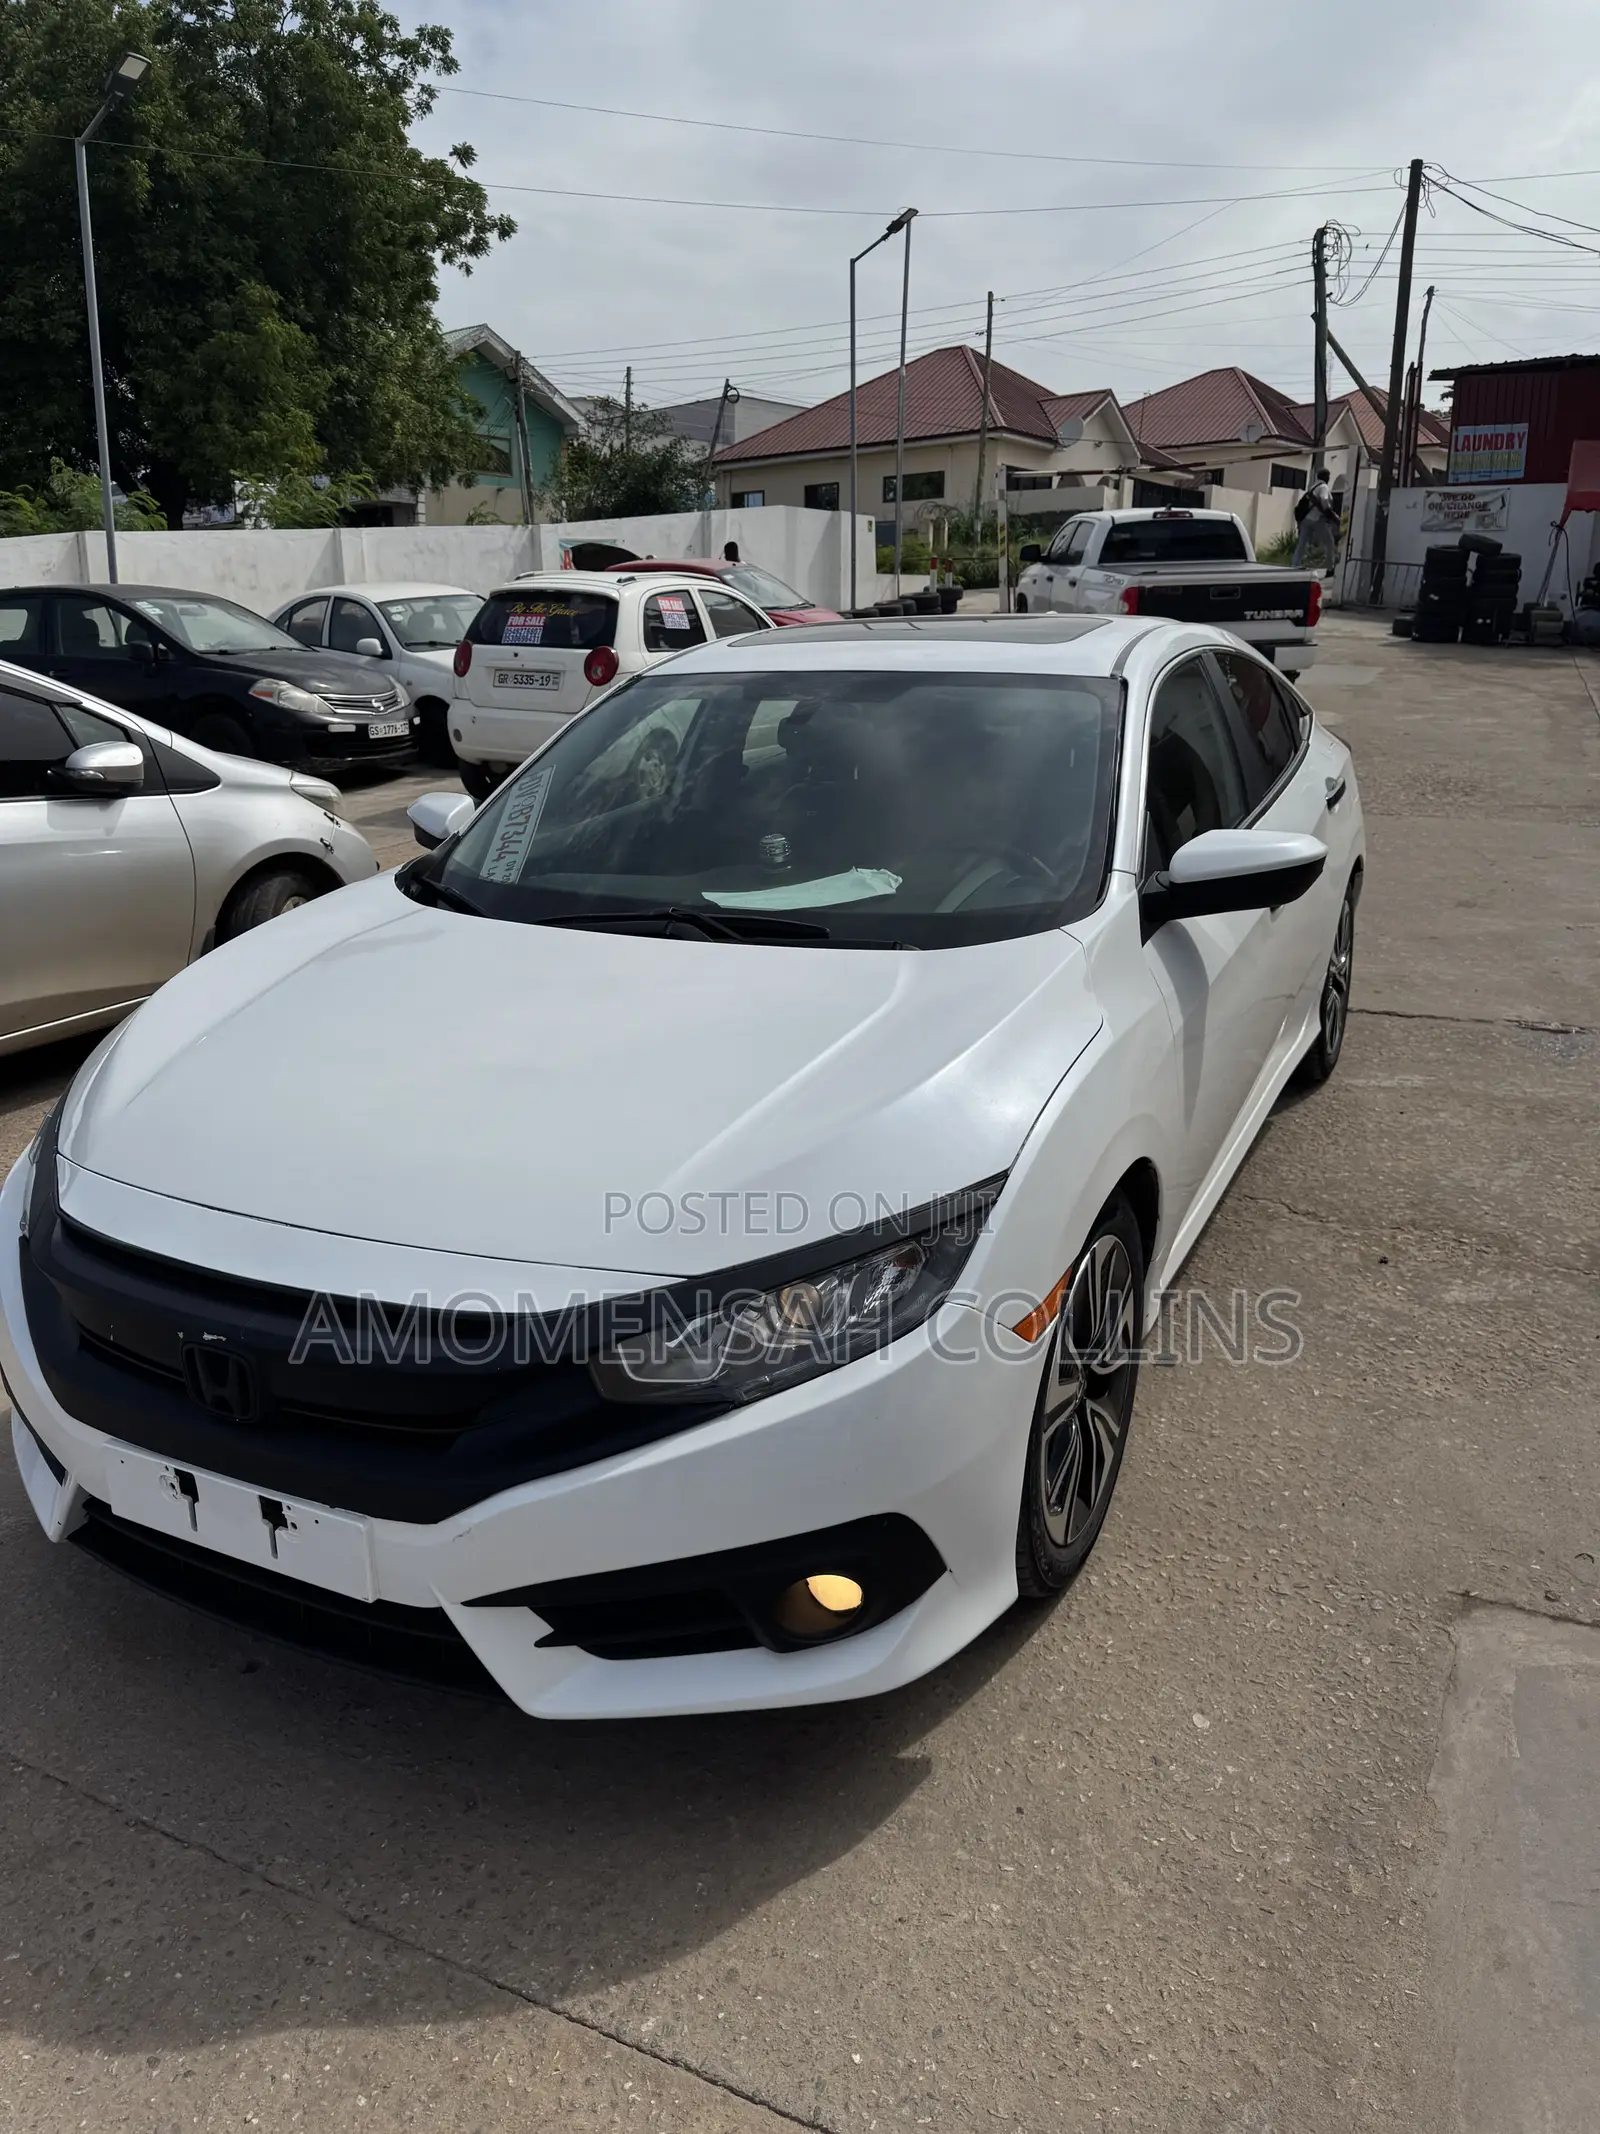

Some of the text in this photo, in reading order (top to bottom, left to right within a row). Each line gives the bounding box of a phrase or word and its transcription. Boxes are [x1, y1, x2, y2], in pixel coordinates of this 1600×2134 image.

[1453, 432, 1527, 452] LAUNDRY
[1243, 609, 1304, 620] TUNDRA
[507, 616, 546, 626] FOR SALE
[498, 674, 509, 684] GR
[513, 674, 551, 687] 5335-19
[370, 726, 380, 736] GS
